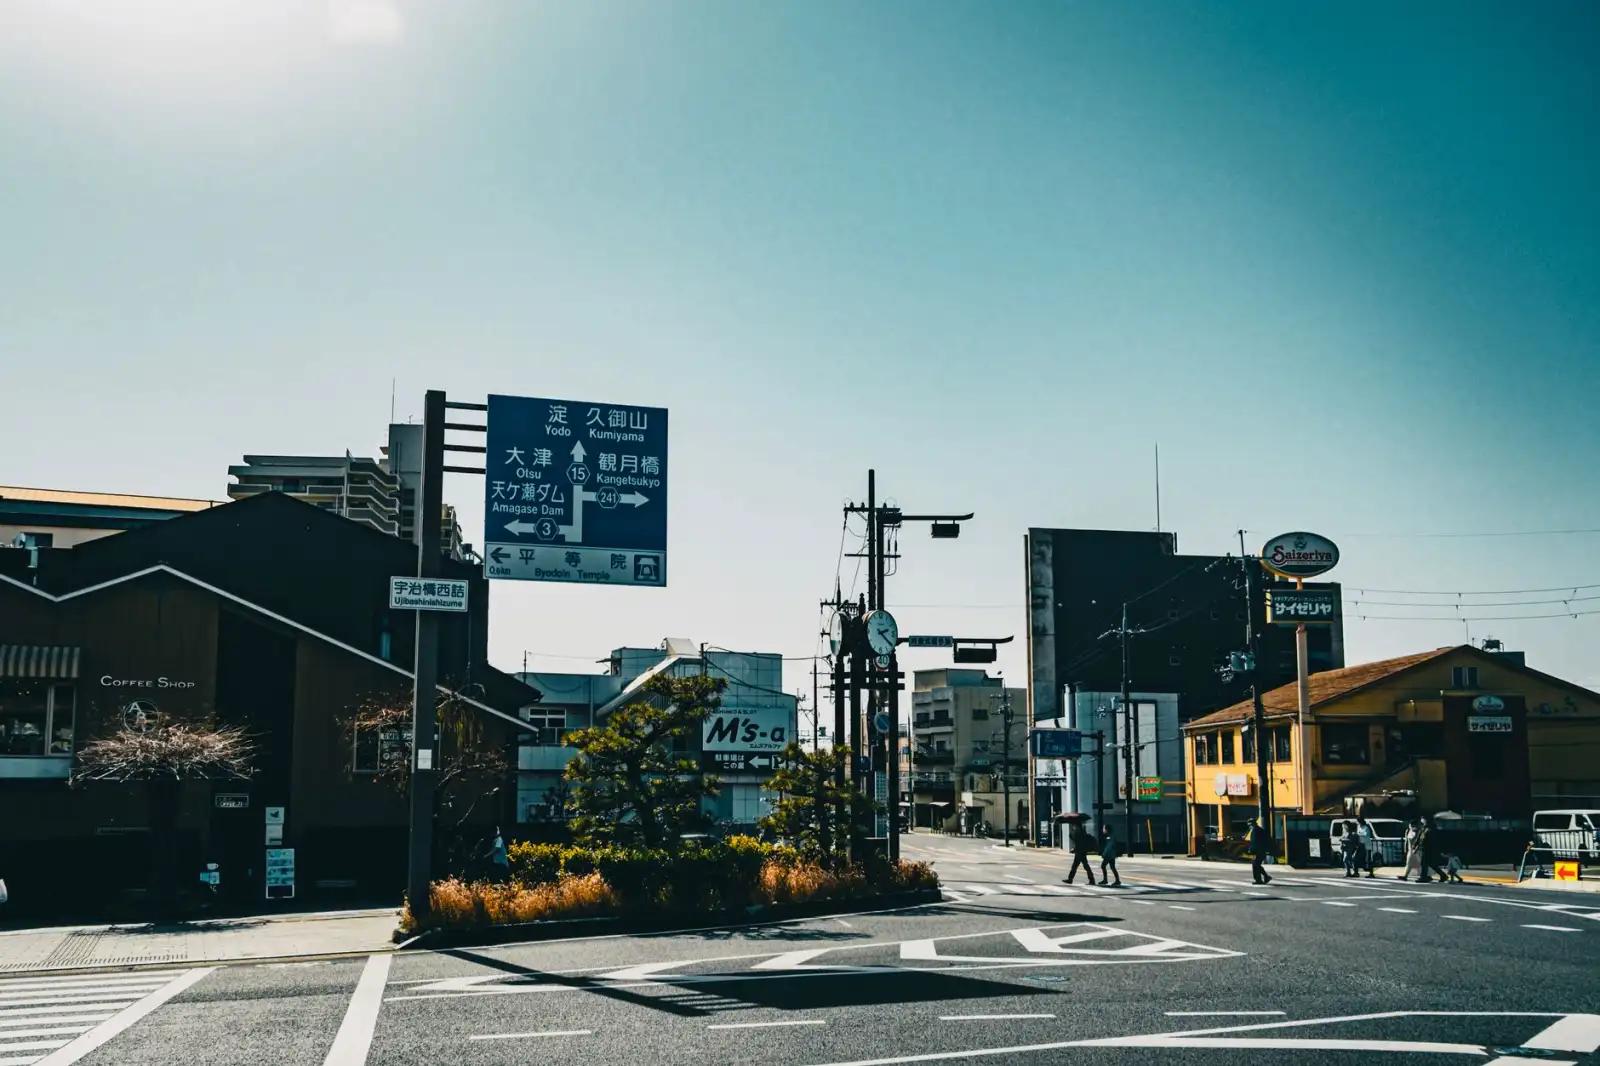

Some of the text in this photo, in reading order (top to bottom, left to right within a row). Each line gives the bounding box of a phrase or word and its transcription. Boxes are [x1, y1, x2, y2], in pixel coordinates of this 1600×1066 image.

[548, 405, 568, 424] 淀
[586, 407, 648, 430] 久御山
[544, 424, 571, 437] Yodo
[589, 428, 645, 443] Kumiyama
[504, 446, 553, 467] 大津
[598, 452, 660, 475] 観月橋
[516, 467, 542, 479] Otsu
[571, 467, 586, 481] 15
[596, 473, 660, 488] Kangetsukyo
[600, 491, 617, 503] 241
[492, 501, 564, 515] Amagase Dam
[542, 522, 551, 535] 3
[519, 548, 627, 570] 平等院
[1271, 544, 1333, 564] Saizeriya
[534, 567, 611, 582] Byodoin Temple
[394, 581, 464, 597] 宇治橋西詰
[394, 597, 462, 607] Ujibashinishizume
[1275, 602, 1332, 616] サイゼリヤ
